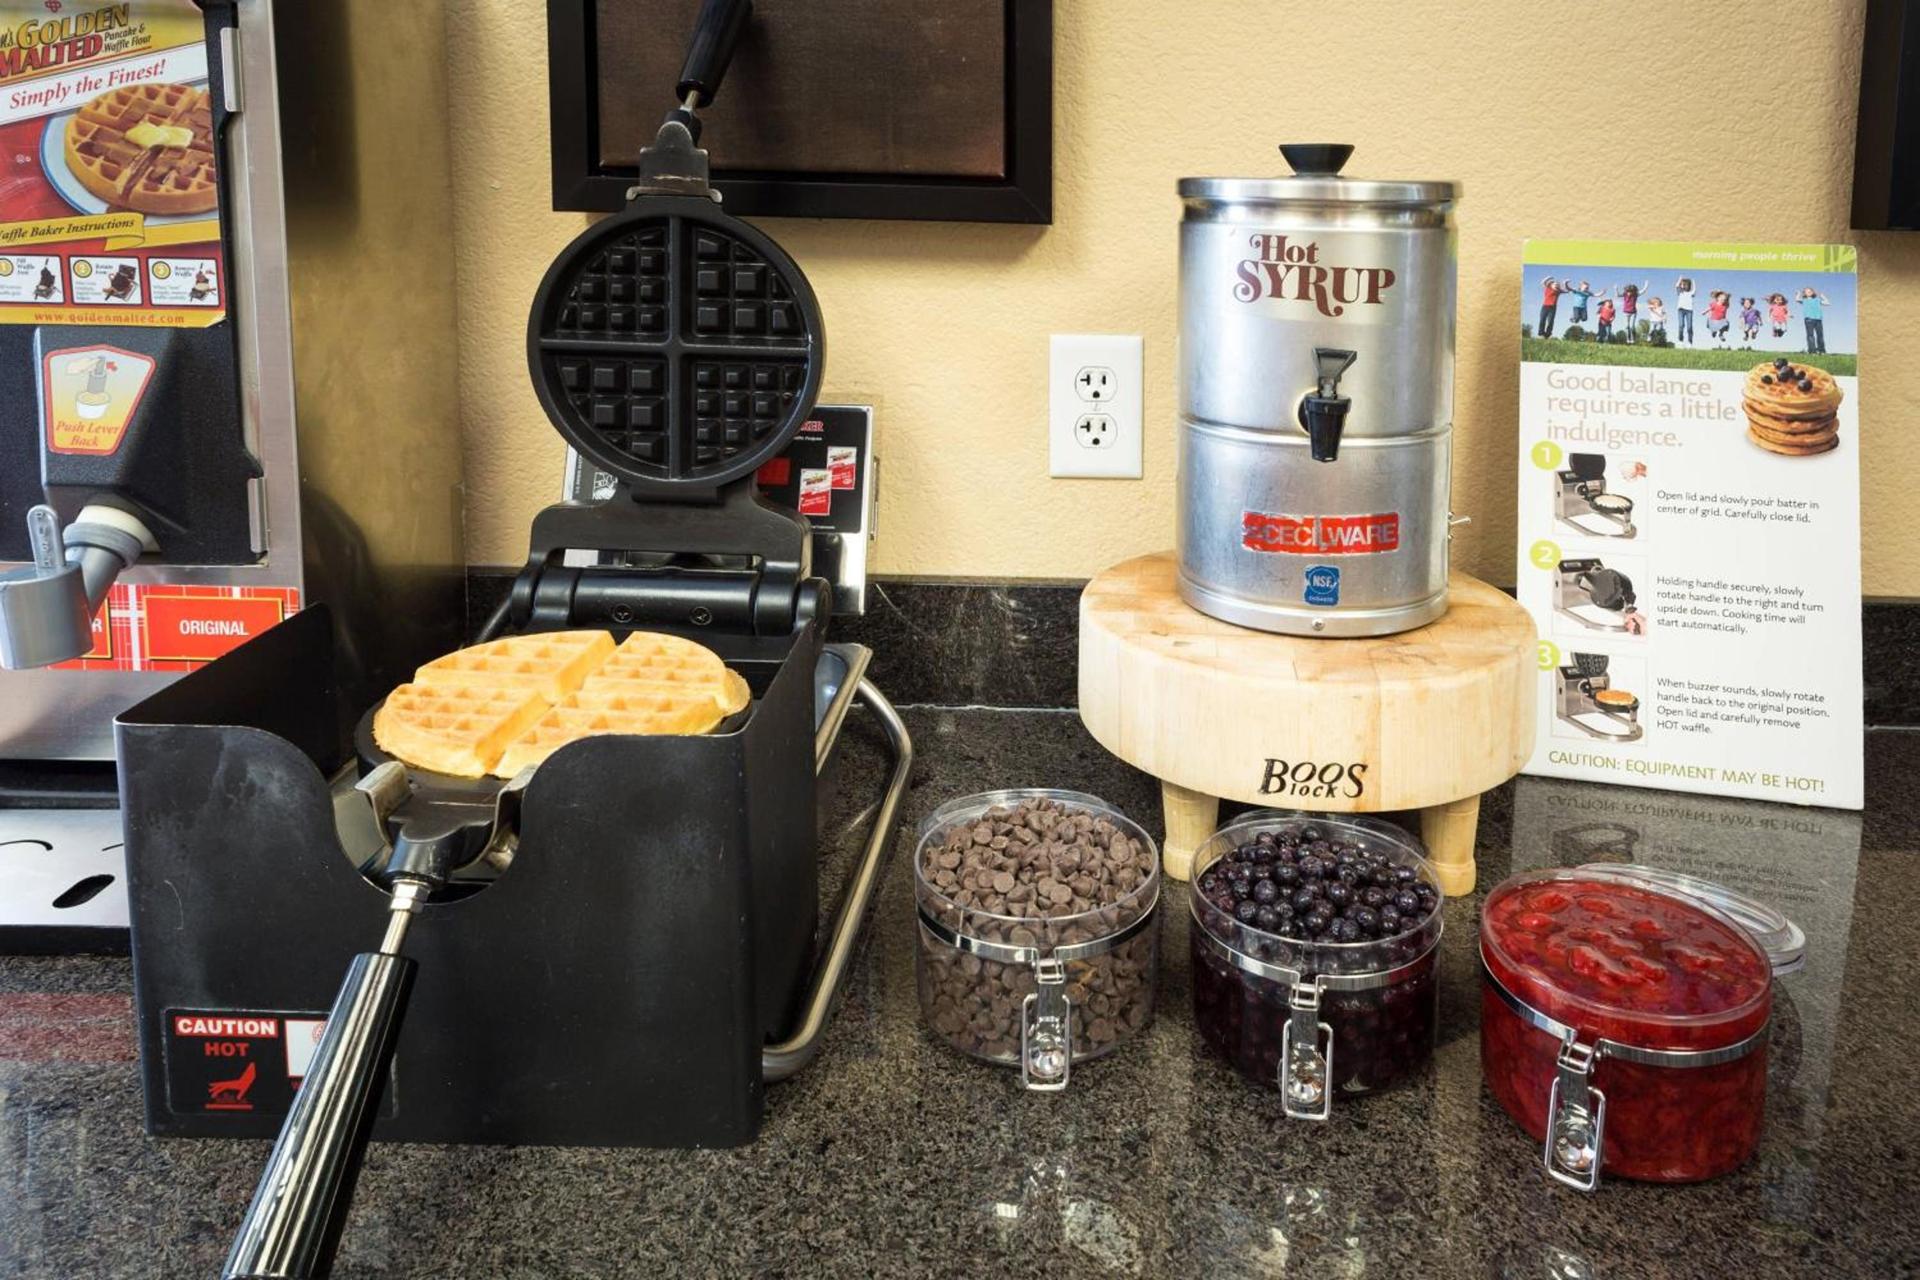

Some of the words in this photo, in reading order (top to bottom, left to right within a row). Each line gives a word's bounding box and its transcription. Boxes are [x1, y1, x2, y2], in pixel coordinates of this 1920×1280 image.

[16, 3, 129, 49] GOLDEN
[103, 25, 138, 42] Pancake
[103, 40, 130, 53] Waffle
[131, 35, 152, 47] Flour
[0, 34, 104, 78] MALTED
[10, 82, 71, 109] Simply
[75, 76, 103, 95] the
[108, 59, 166, 88] Finest!
[0, 227, 27, 241] affle
[30, 225, 65, 237] Baker
[66, 219, 135, 234] Instructions
[1249, 234, 1320, 264] Hot
[1739, 252, 1778, 263] people
[1781, 252, 1817, 262] thrive
[1233, 259, 1396, 317] SYRUP
[1547, 369, 1611, 393] Good
[1620, 371, 1712, 396] balance
[1547, 395, 1651, 419] requires
[1659, 403, 1674, 418] a
[1681, 397, 1736, 421] little
[56, 420, 85, 433] Push
[88, 422, 119, 435] Lever
[1547, 419, 1683, 450] indulgence.
[70, 434, 98, 447] Back
[1540, 447, 1550, 464] 1
[1656, 490, 1683, 501] Open
[1685, 492, 1697, 502] lid
[1699, 493, 1718, 503] and
[1719, 494, 1749, 507] slowly
[1751, 498, 1774, 507] pour
[1776, 497, 1808, 510] batter
[1809, 501, 1820, 510] in
[1656, 504, 1688, 515] center
[1689, 506, 1699, 515] of
[1700, 507, 1722, 518] grid.
[1724, 508, 1768, 522] Carefully
[1769, 512, 1794, 522] close
[1796, 513, 1811, 523] lid.
[1263, 522, 1397, 550] CECILWARE
[1539, 547, 1554, 565] 2
[1312, 575, 1334, 588] NSF
[1656, 576, 1694, 589] Holding
[1696, 578, 1729, 590] handle
[1730, 583, 1772, 595] securely,
[1773, 586, 1805, 599] slowly
[1656, 591, 1686, 601] rotate
[1688, 592, 1721, 604] handle
[1723, 595, 1734, 605] to
[1736, 596, 1752, 606] the
[1754, 598, 1778, 610] right
[1780, 600, 1800, 610] and
[1801, 602, 1824, 612] turn
[1656, 604, 1688, 616] upside
[1690, 606, 1720, 617] down.
[1721, 608, 1762, 623] Cooking
[1763, 612, 1787, 623] time
[1788, 615, 1806, 624] will
[179, 619, 249, 636] ORIGINAL
[1656, 617, 1679, 627] start
[1681, 619, 1749, 635] automatically.
[1538, 646, 1552, 666] 3
[1656, 678, 1685, 689] When
[1687, 680, 1720, 692] buzzer
[1722, 685, 1759, 697] sounds,
[1761, 687, 1791, 701] slowly
[1793, 692, 1825, 703] rotate
[1656, 692, 1690, 704] handle
[1691, 694, 1714, 706] back
[1715, 698, 1727, 708] to
[1728, 699, 1746, 710] the
[1747, 701, 1784, 714] original
[1656, 705, 1684, 718] Open
[1685, 707, 1698, 718] lid
[1699, 709, 1719, 720] and
[1720, 711, 1761, 726] carefully
[1763, 718, 1801, 730] remove
[1656, 719, 1679, 731] HOT
[1681, 722, 1713, 734] waffle.
[1548, 750, 1621, 771] CAUTION:
[1625, 759, 1716, 781] EQUIPMENT
[1721, 769, 1756, 785] MAY
[1761, 774, 1780, 788] BE
[1785, 776, 1825, 793] HOT!
[177, 1018, 276, 1036] CAUTION
[204, 1042, 249, 1057] HOT
